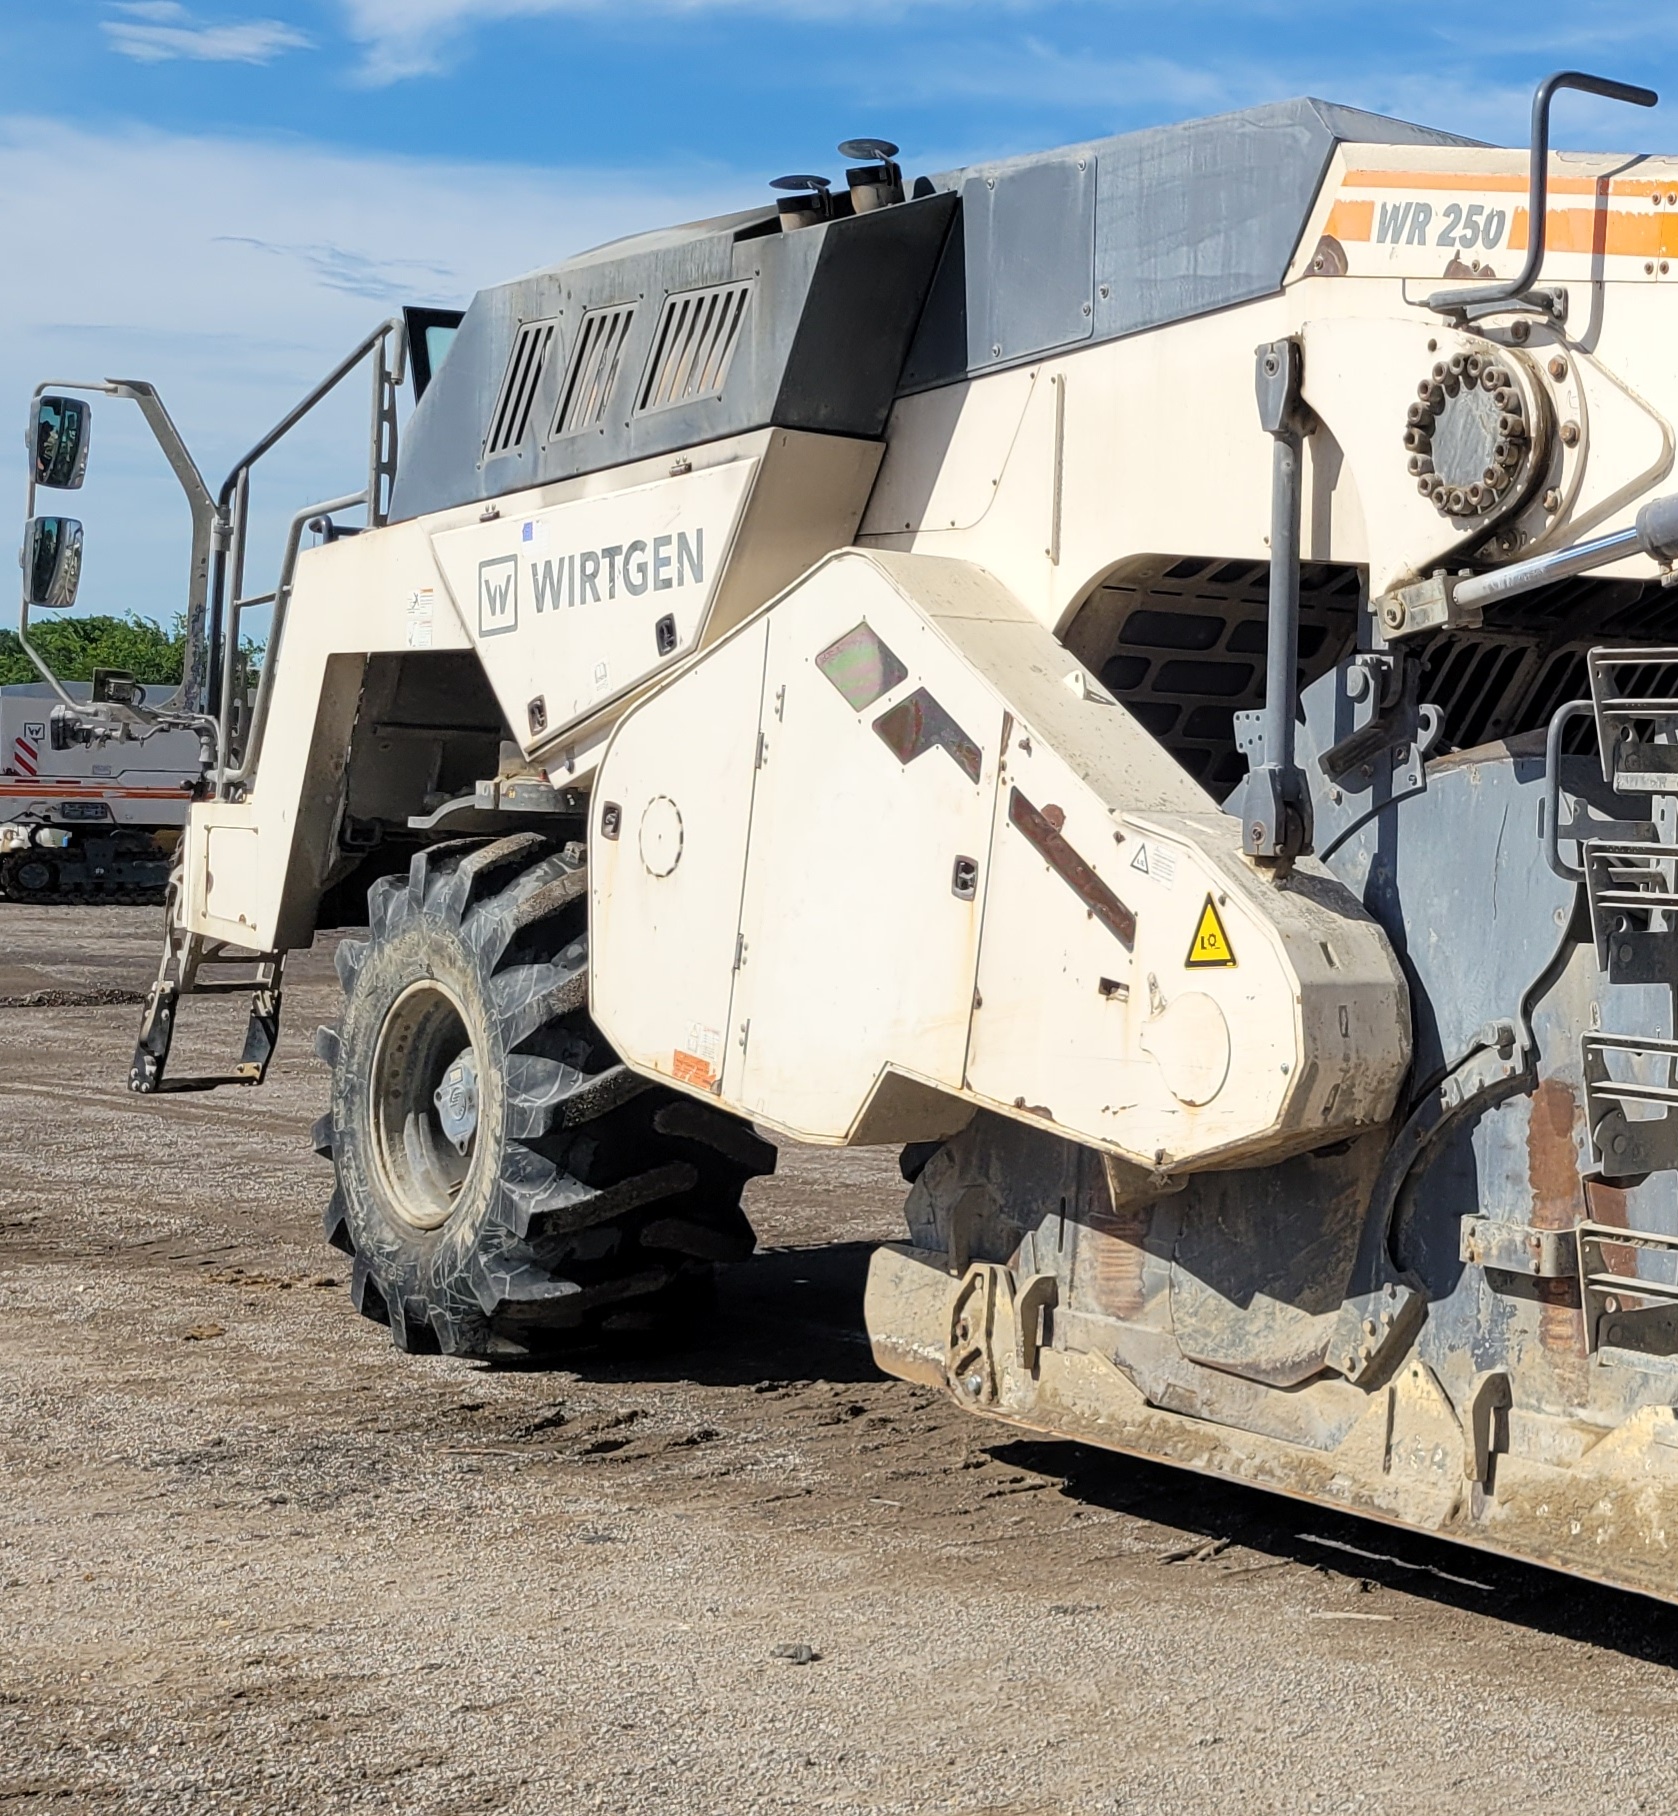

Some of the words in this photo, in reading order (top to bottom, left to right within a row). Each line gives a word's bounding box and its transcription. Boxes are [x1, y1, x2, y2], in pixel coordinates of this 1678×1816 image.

[1376, 201, 1432, 246] WR
[1436, 202, 1506, 250] 250
[530, 527, 704, 614] WIRTGEN
